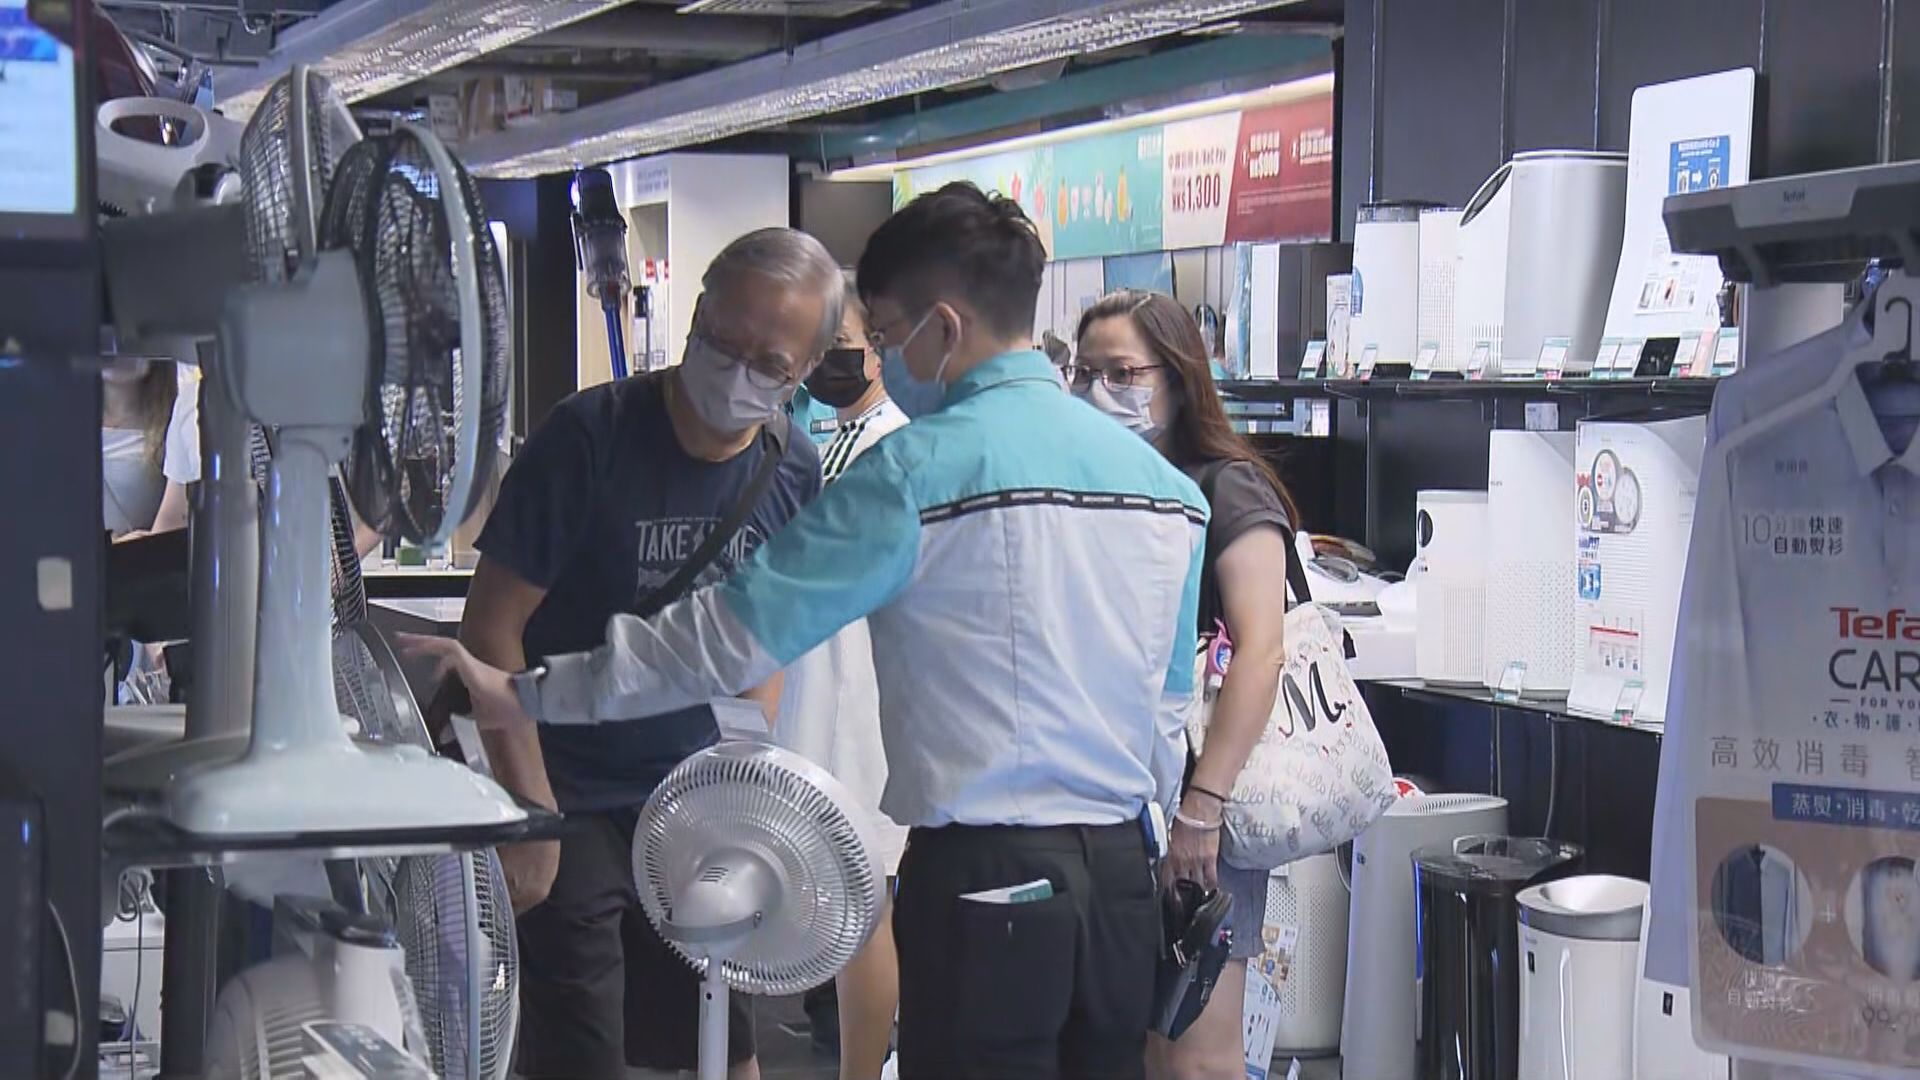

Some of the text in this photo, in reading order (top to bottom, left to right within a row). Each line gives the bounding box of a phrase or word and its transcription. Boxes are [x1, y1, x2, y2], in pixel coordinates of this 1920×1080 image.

[635, 520, 691, 562] TAKE
[1829, 649, 1920, 692] CAR
[1860, 697, 1920, 711] FOR YO
[1710, 735, 1870, 778] 高效消毒
